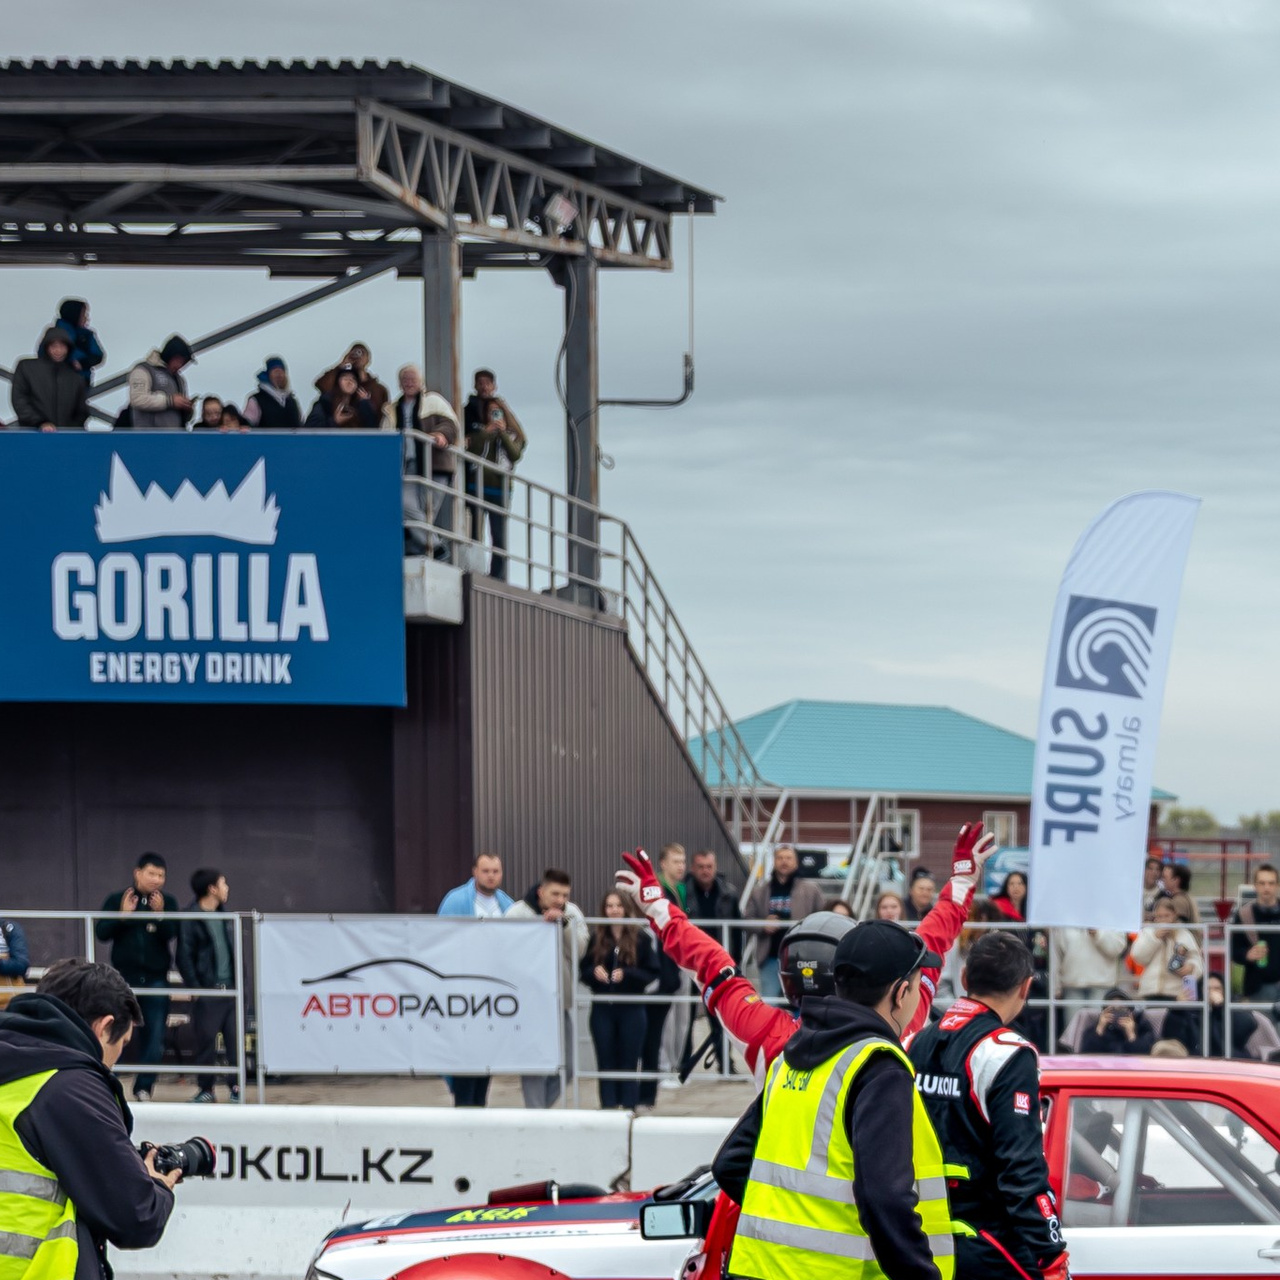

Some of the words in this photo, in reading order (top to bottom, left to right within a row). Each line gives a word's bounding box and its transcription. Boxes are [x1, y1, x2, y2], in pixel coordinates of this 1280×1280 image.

[52, 552, 329, 641] GORILLA
[90, 652, 200, 683] ENERGY
[206, 653, 292, 683] DRINK
[914, 1072, 961, 1097] LUKOIL
[203, 1145, 434, 1184] OKOL.KZ
